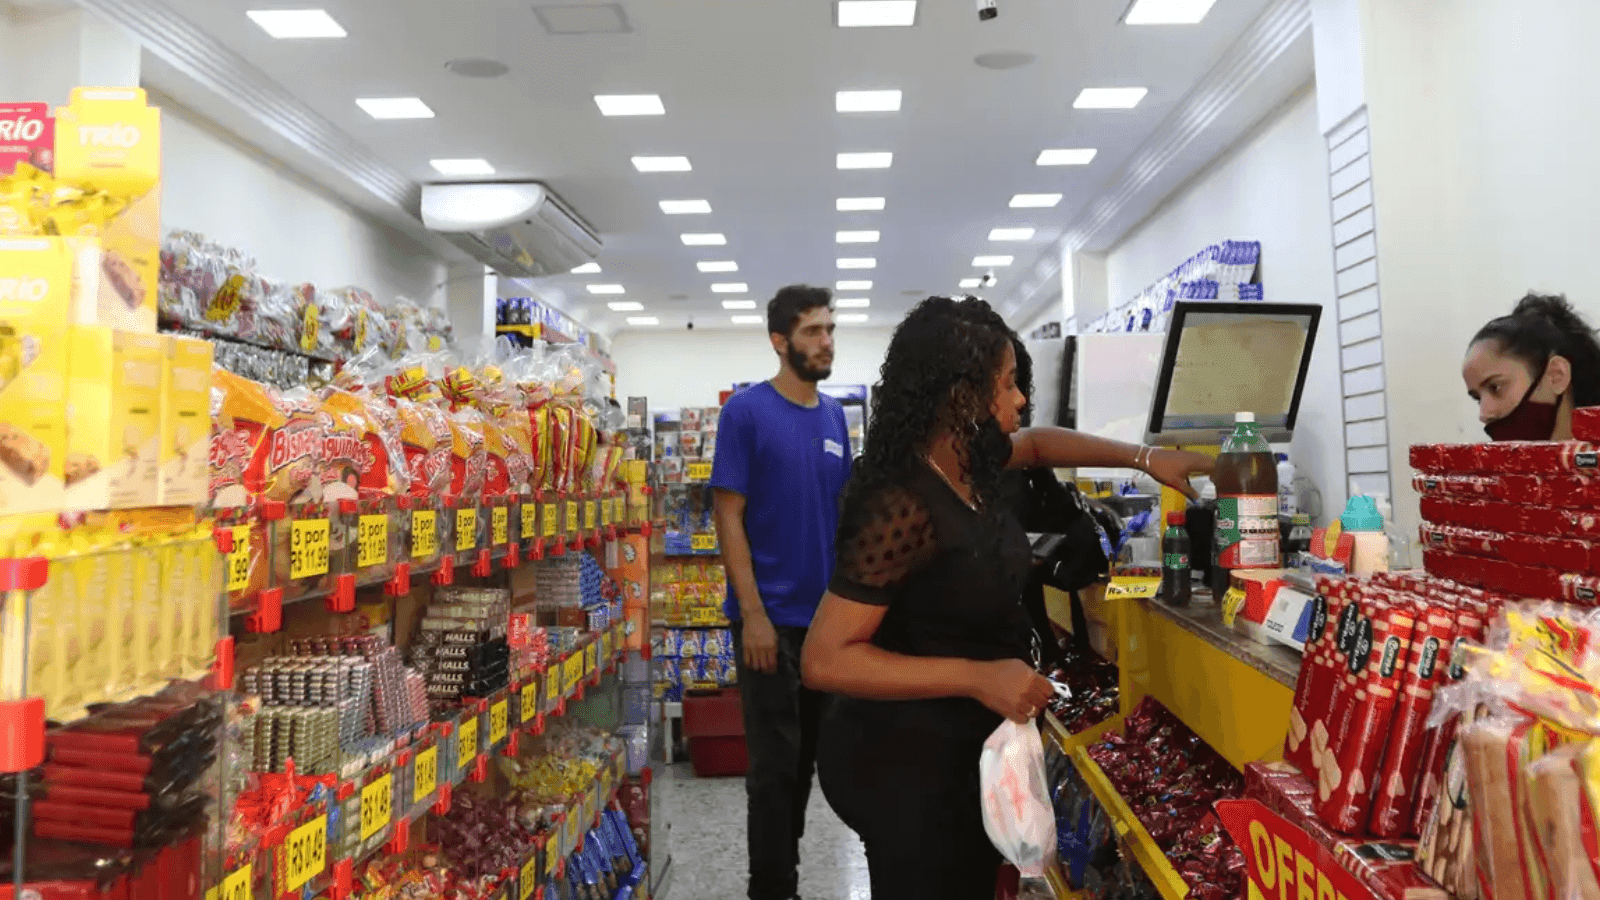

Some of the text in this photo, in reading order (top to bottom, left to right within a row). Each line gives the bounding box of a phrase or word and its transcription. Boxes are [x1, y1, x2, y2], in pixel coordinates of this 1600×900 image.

[0, 115, 44, 141] RÍO
[0, 275, 49, 302] RÍO
[360, 522, 384, 542] 3 por
[413, 517, 433, 533] 3 por
[231, 538, 244, 554] or
[293, 528, 325, 549] 3 por
[291, 546, 327, 573] R$ 11.99
[358, 538, 386, 561] R$ 11.99
[230, 557, 248, 583] .99
[445, 633, 476, 642] HALLS
[435, 647, 467, 656] HALLS
[438, 661, 470, 670] HALLS
[432, 673, 464, 682] HALLS
[427, 684, 459, 693] HALLS
[363, 794, 373, 830] R$
[291, 838, 303, 878] R$
[1248, 819, 1348, 900] OFE
